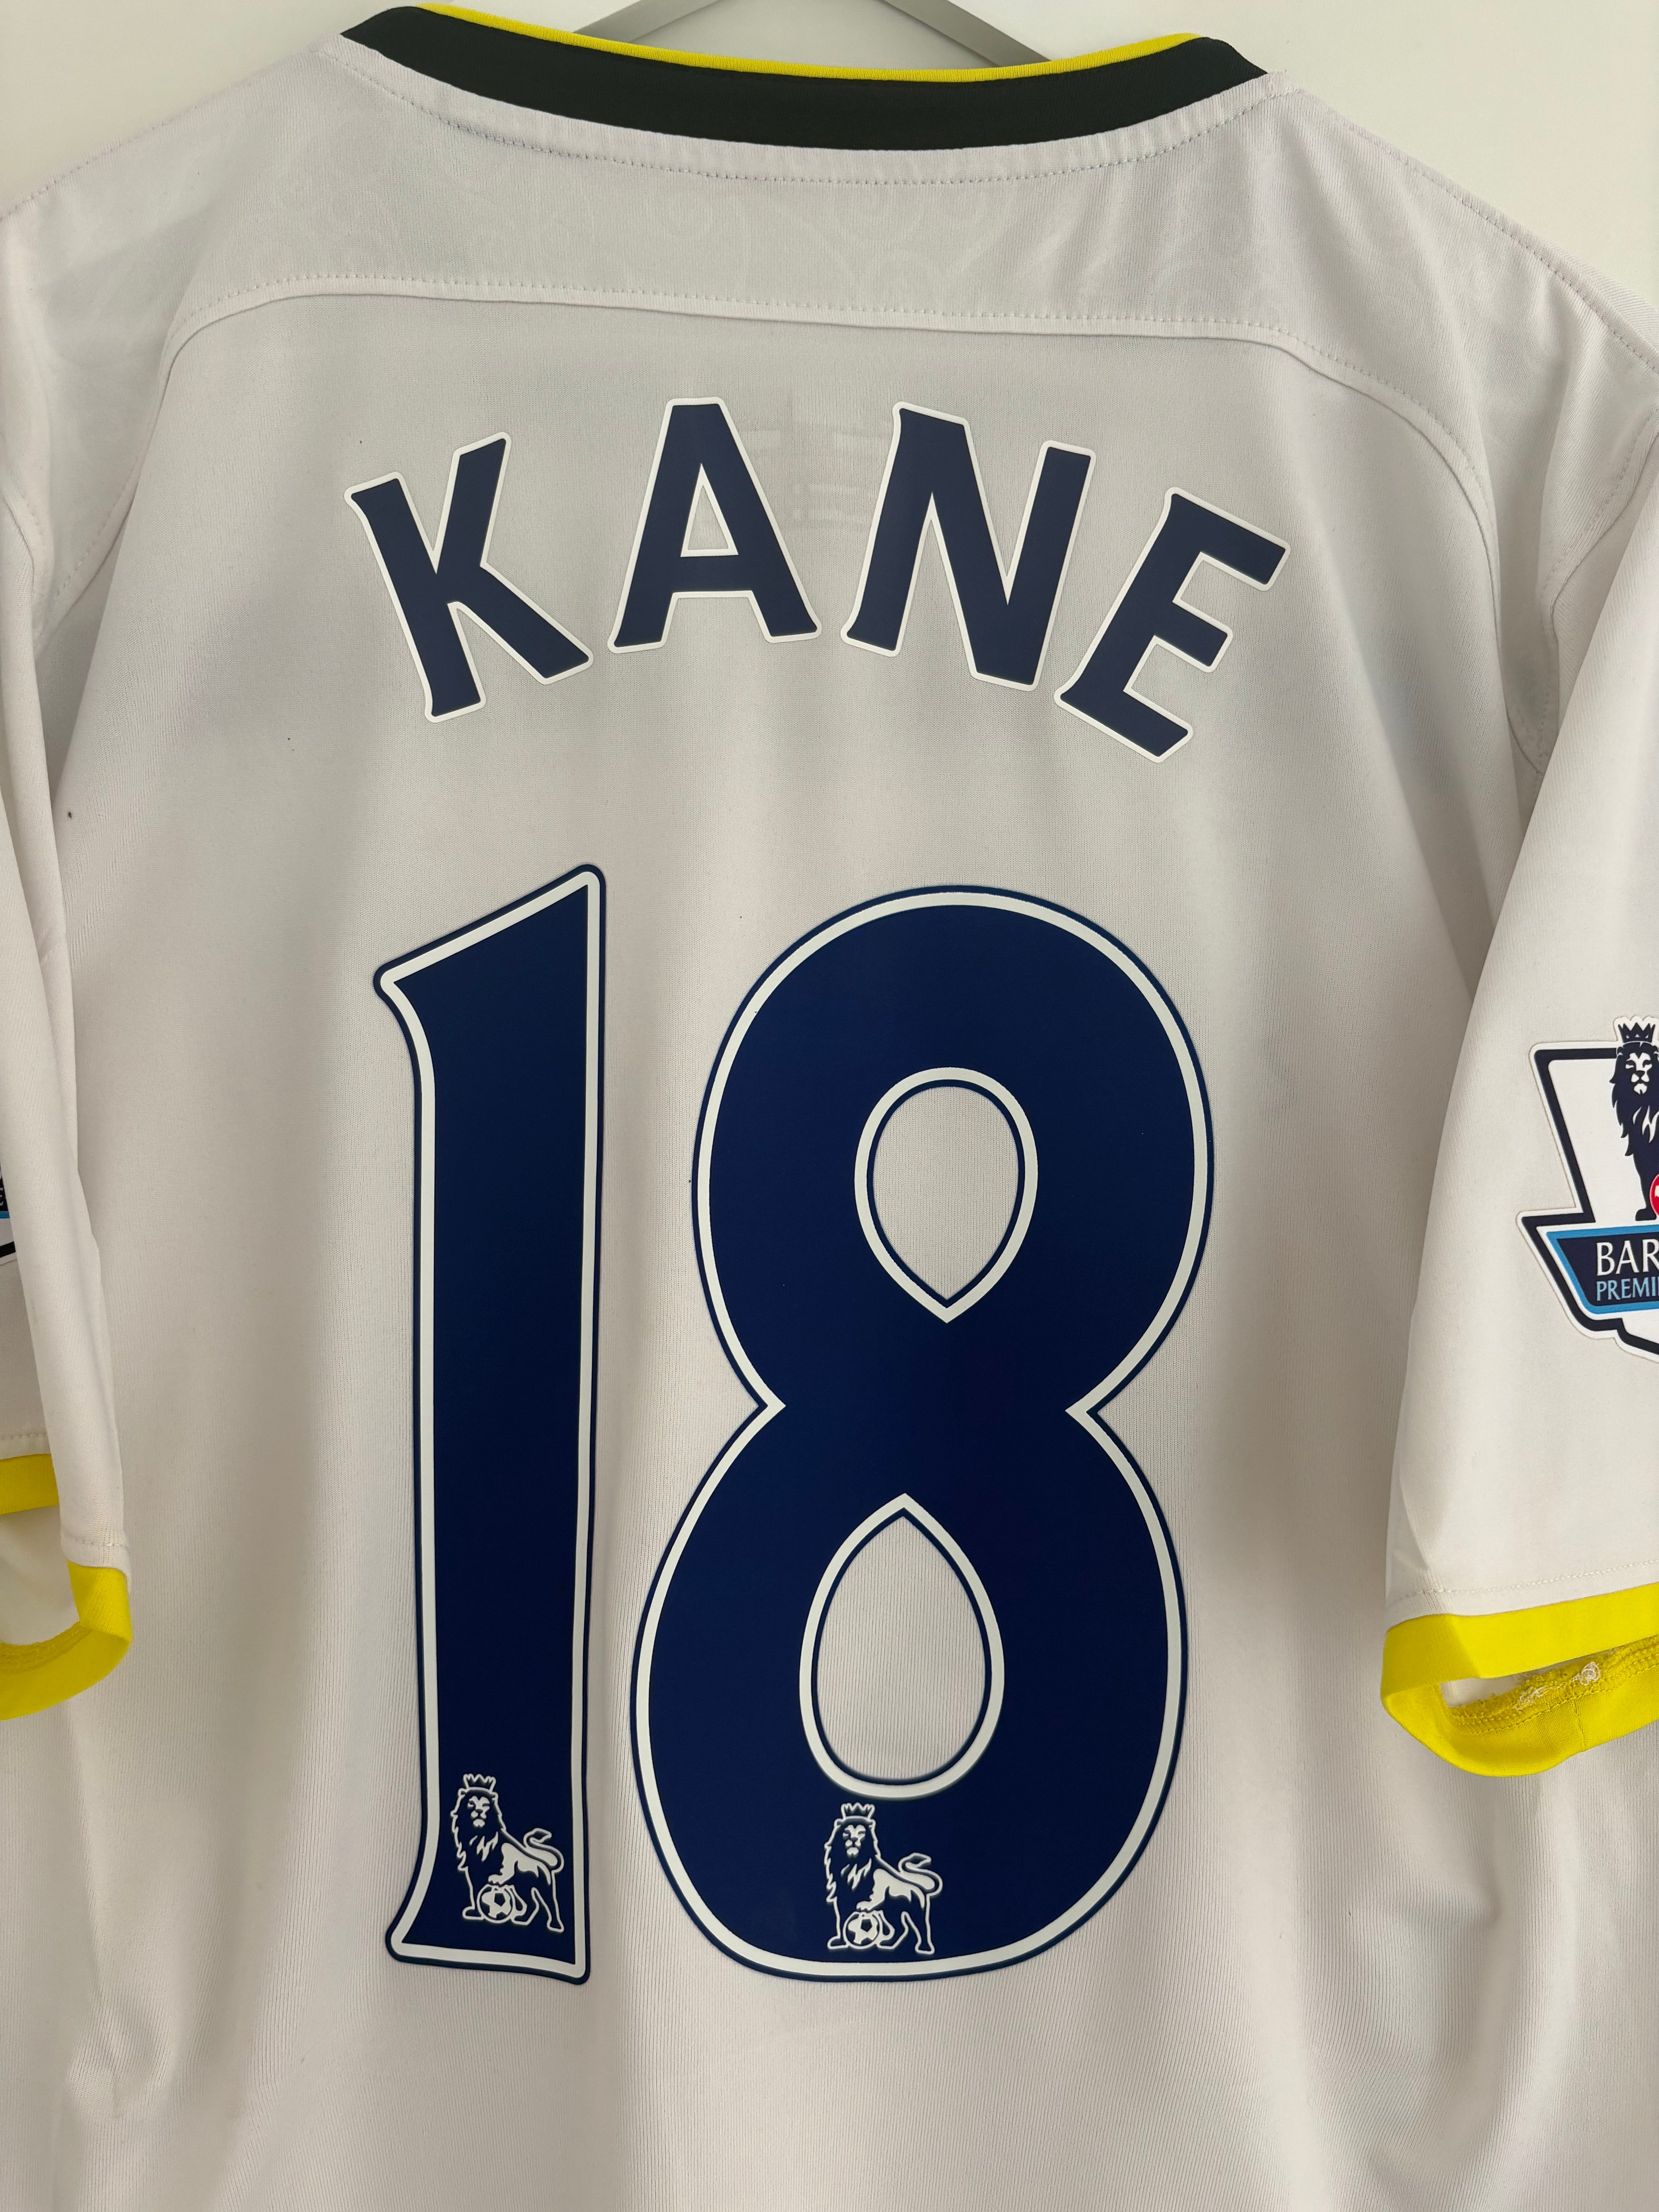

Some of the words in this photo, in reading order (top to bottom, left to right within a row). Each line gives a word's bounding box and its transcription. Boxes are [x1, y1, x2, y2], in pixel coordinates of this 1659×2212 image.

[345, 397, 1290, 762] KANE
[1596, 1239, 1659, 1276] BAR
[1596, 1276, 1659, 1301] PREMI
[373, 864, 1214, 1986] 18
